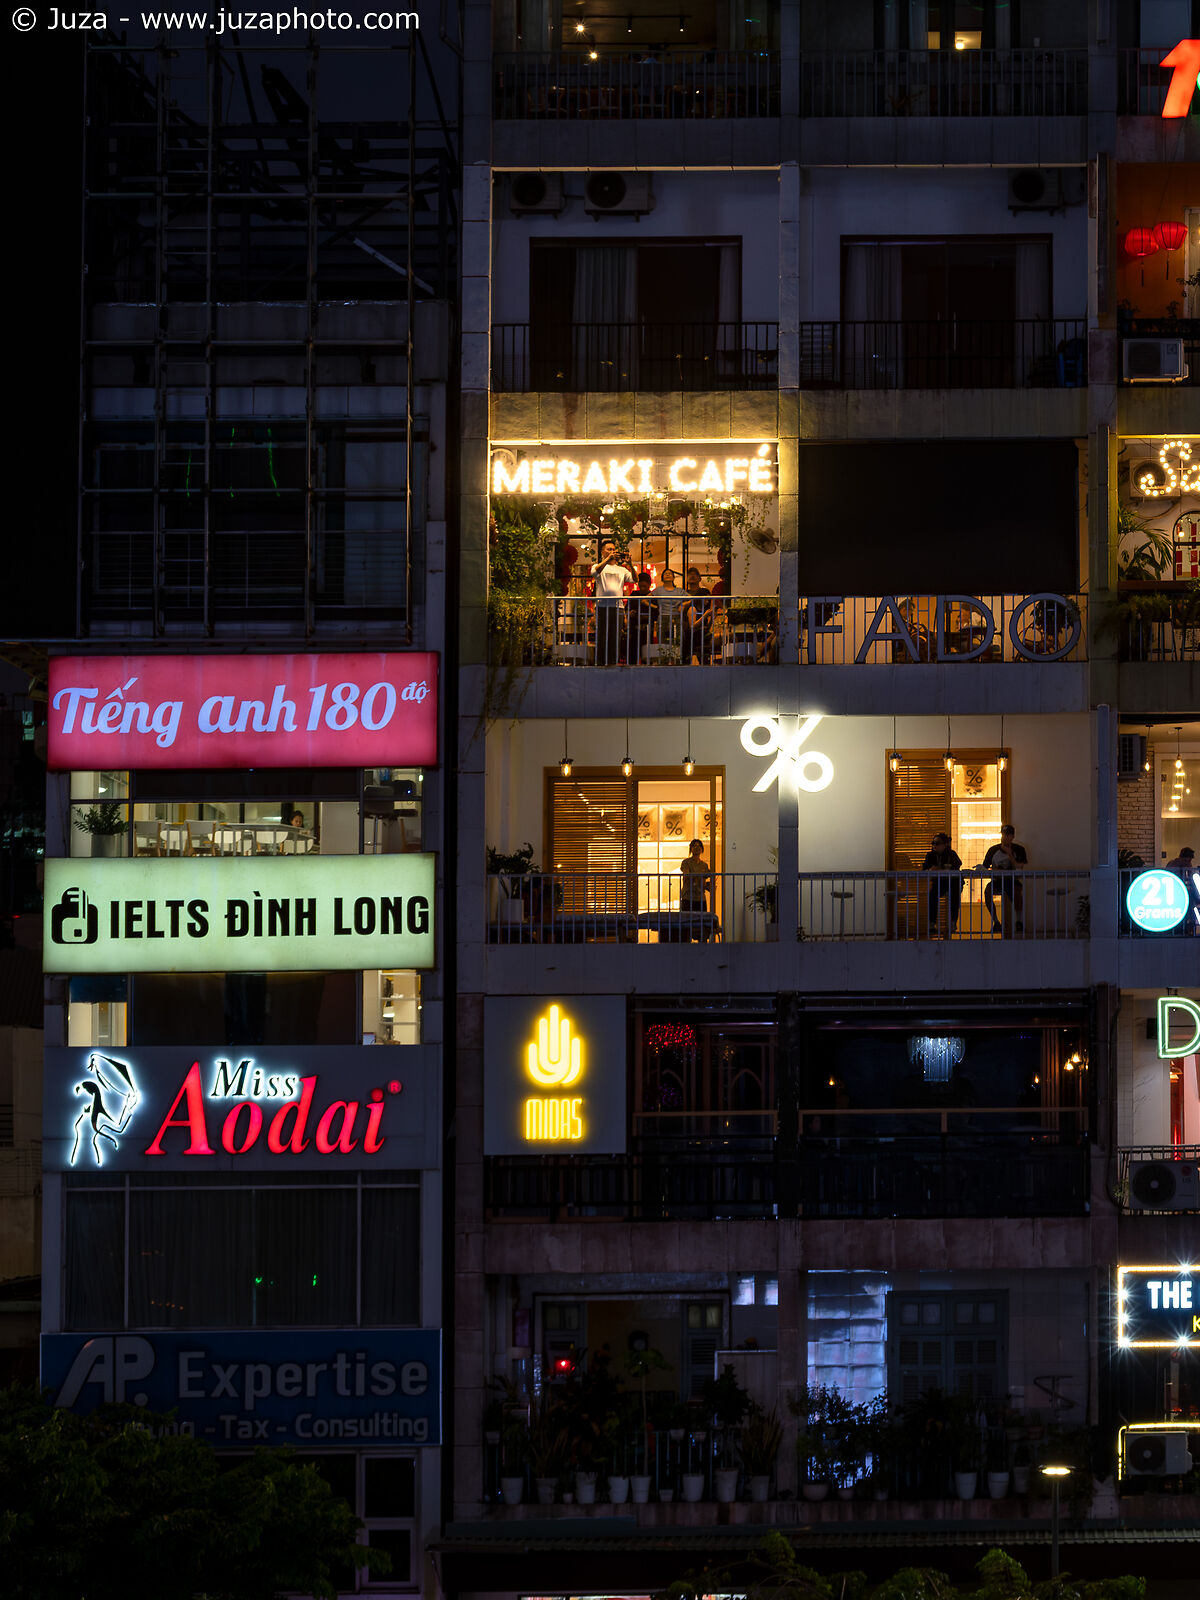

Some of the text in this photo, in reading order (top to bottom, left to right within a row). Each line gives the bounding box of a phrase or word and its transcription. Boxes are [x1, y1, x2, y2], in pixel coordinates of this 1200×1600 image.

[491, 442, 774, 494] MERAKI CAFÉ
[806, 591, 1083, 665] FADO
[52, 677, 432, 748] Tiếng anh 180 độ
[1133, 906, 1182, 920] Grams
[1141, 876, 1176, 906] 21
[110, 890, 431, 939] IELTS ĐÌNH LONG
[210, 1058, 299, 1098] Miss
[144, 1060, 386, 1156] Aodai
[525, 1097, 584, 1140] MIDAS
[1147, 1280, 1193, 1309] THE
[177, 1350, 429, 1411] Expertise
[218, 1413, 271, 1440] Tax
[294, 1412, 430, 1442] Consulting
